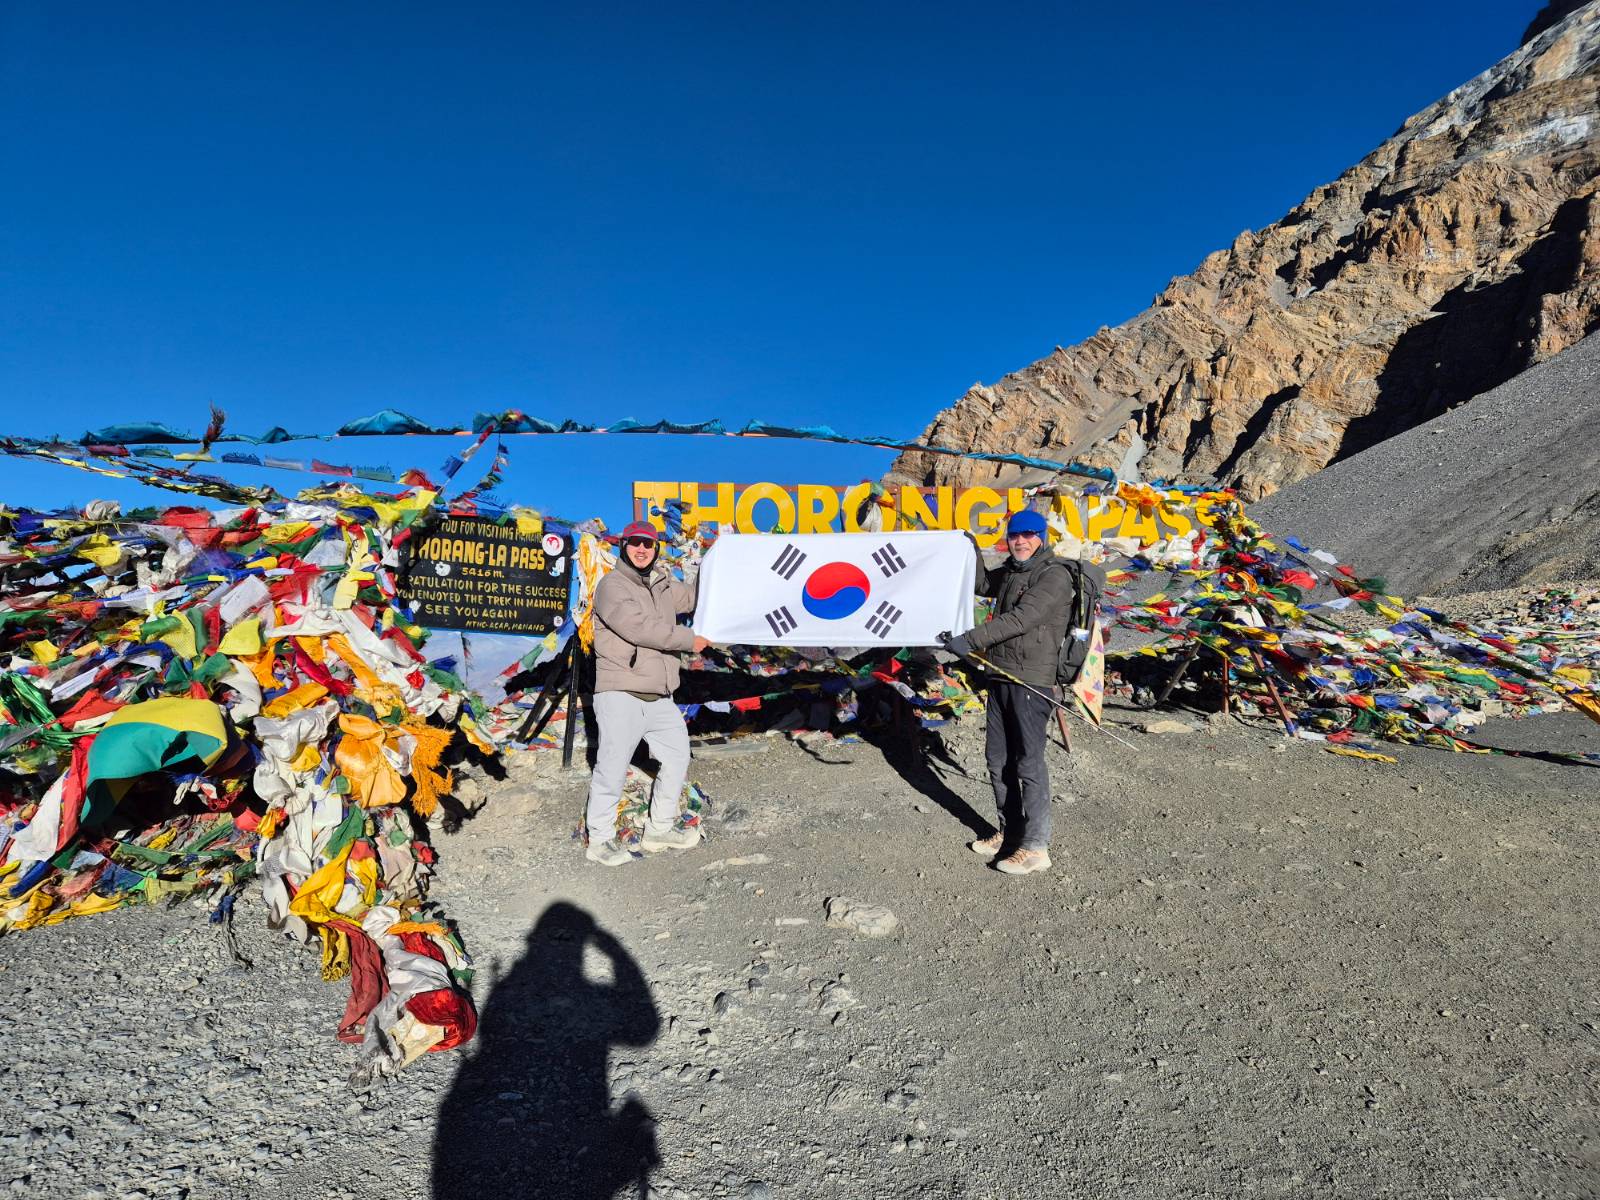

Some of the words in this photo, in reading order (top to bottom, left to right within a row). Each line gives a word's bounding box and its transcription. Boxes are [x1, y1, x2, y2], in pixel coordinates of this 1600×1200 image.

[460, 520, 476, 536] FOR
[477, 522, 514, 541] VISITING
[510, 545, 545, 571] PASS
[461, 567, 491, 577] 5416
[396, 588, 415, 600] YOU
[417, 589, 461, 603] ENJOYED
[464, 593, 484, 605] THE
[487, 595, 512, 607] TREK
[514, 598, 524, 607] IN
[526, 598, 564, 611] MANANG
[477, 581, 499, 594] FOR
[501, 583, 522, 595] THE
[525, 585, 567, 599] SUCCESS
[425, 603, 450, 616] SEE
[455, 606, 479, 618] YOU
[482, 608, 518, 619] AGAIN
